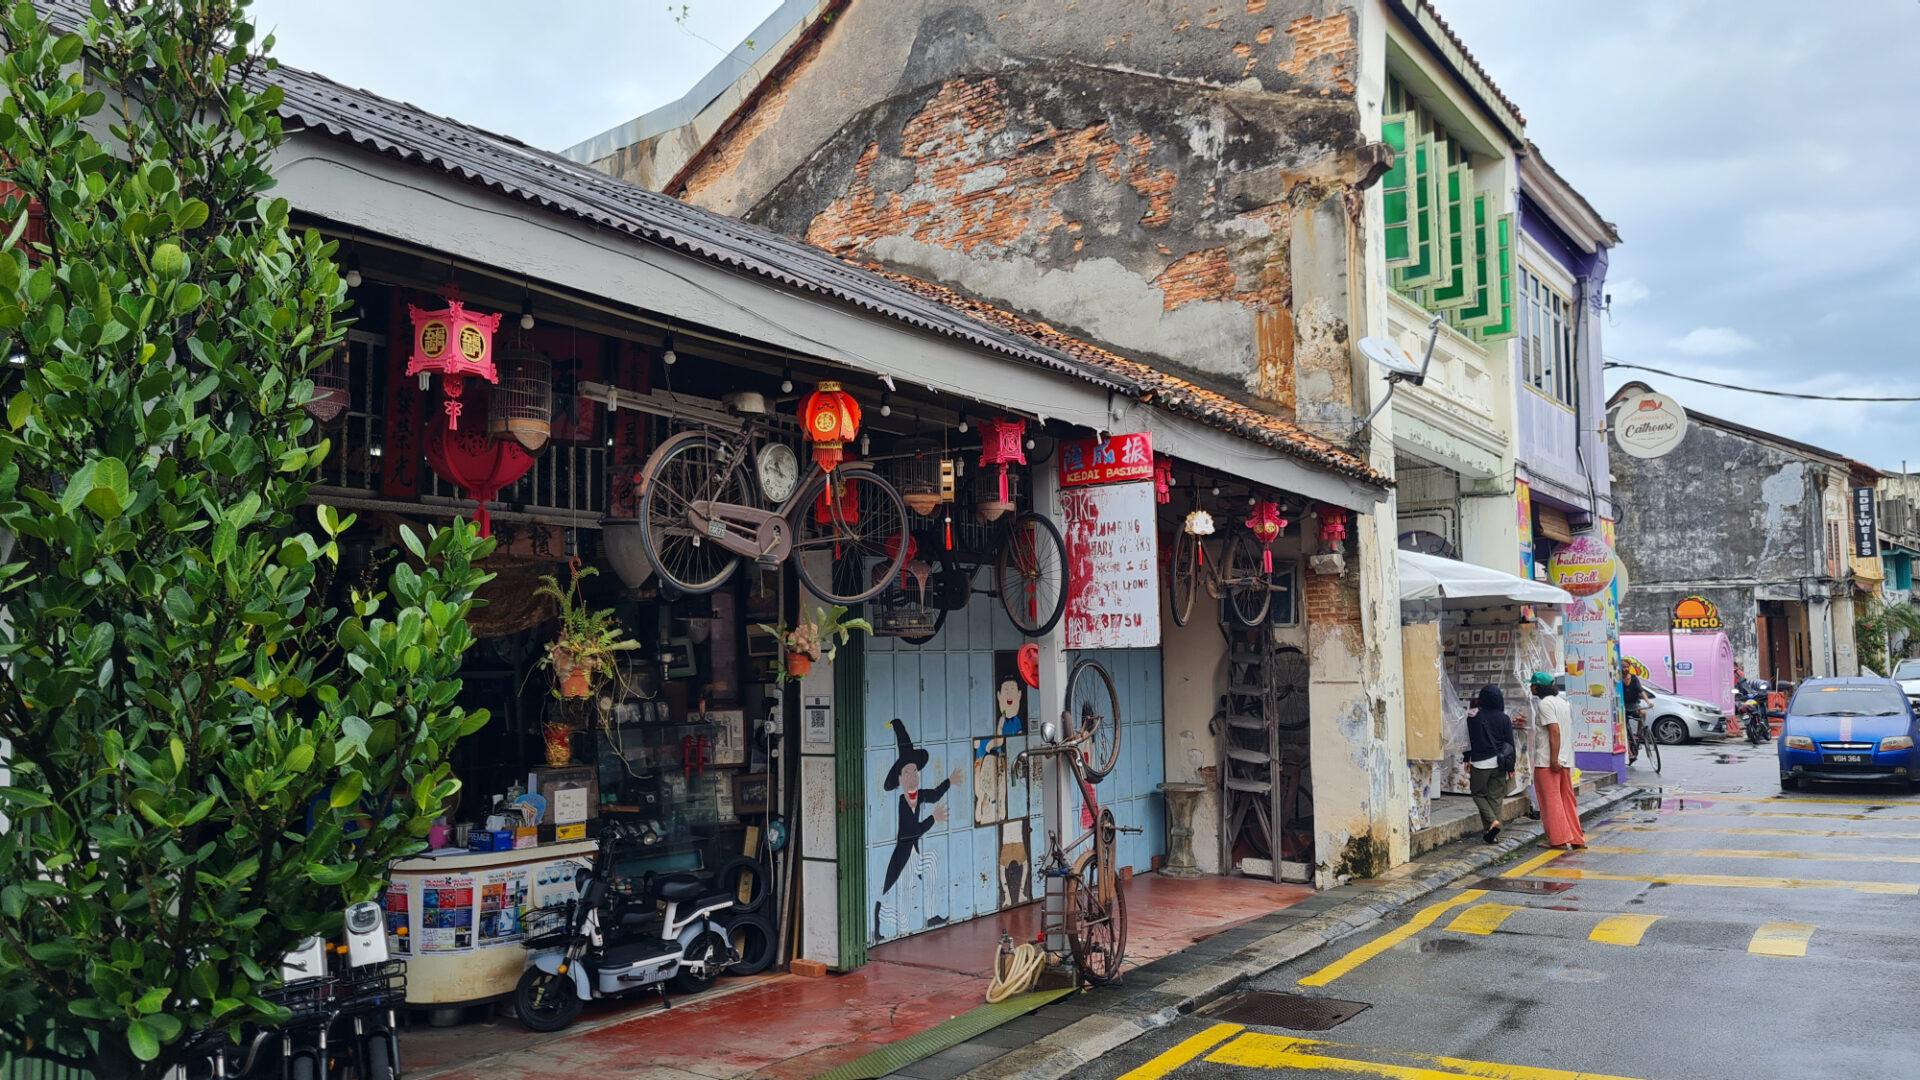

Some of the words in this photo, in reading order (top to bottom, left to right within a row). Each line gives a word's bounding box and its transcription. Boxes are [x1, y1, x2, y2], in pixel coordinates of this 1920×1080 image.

[1625, 422, 1674, 438] Cathouse
[1067, 469, 1101, 482] KEDAI
[1106, 464, 1152, 478] BASIKAL
[1062, 492, 1097, 522] BIKE
[1858, 489, 1872, 556] EDELWEISS
[1553, 551, 1608, 566] Traditional
[1559, 573, 1574, 584] Ice
[1574, 571, 1598, 583] Ball
[1566, 612, 1580, 622] Ice
[1581, 611, 1604, 622] Ball
[1672, 617, 1723, 628] TRACO.
[1582, 707, 1609, 716] Coconut
[1585, 716, 1608, 724] Shake
[1577, 732, 1588, 740] Ice
